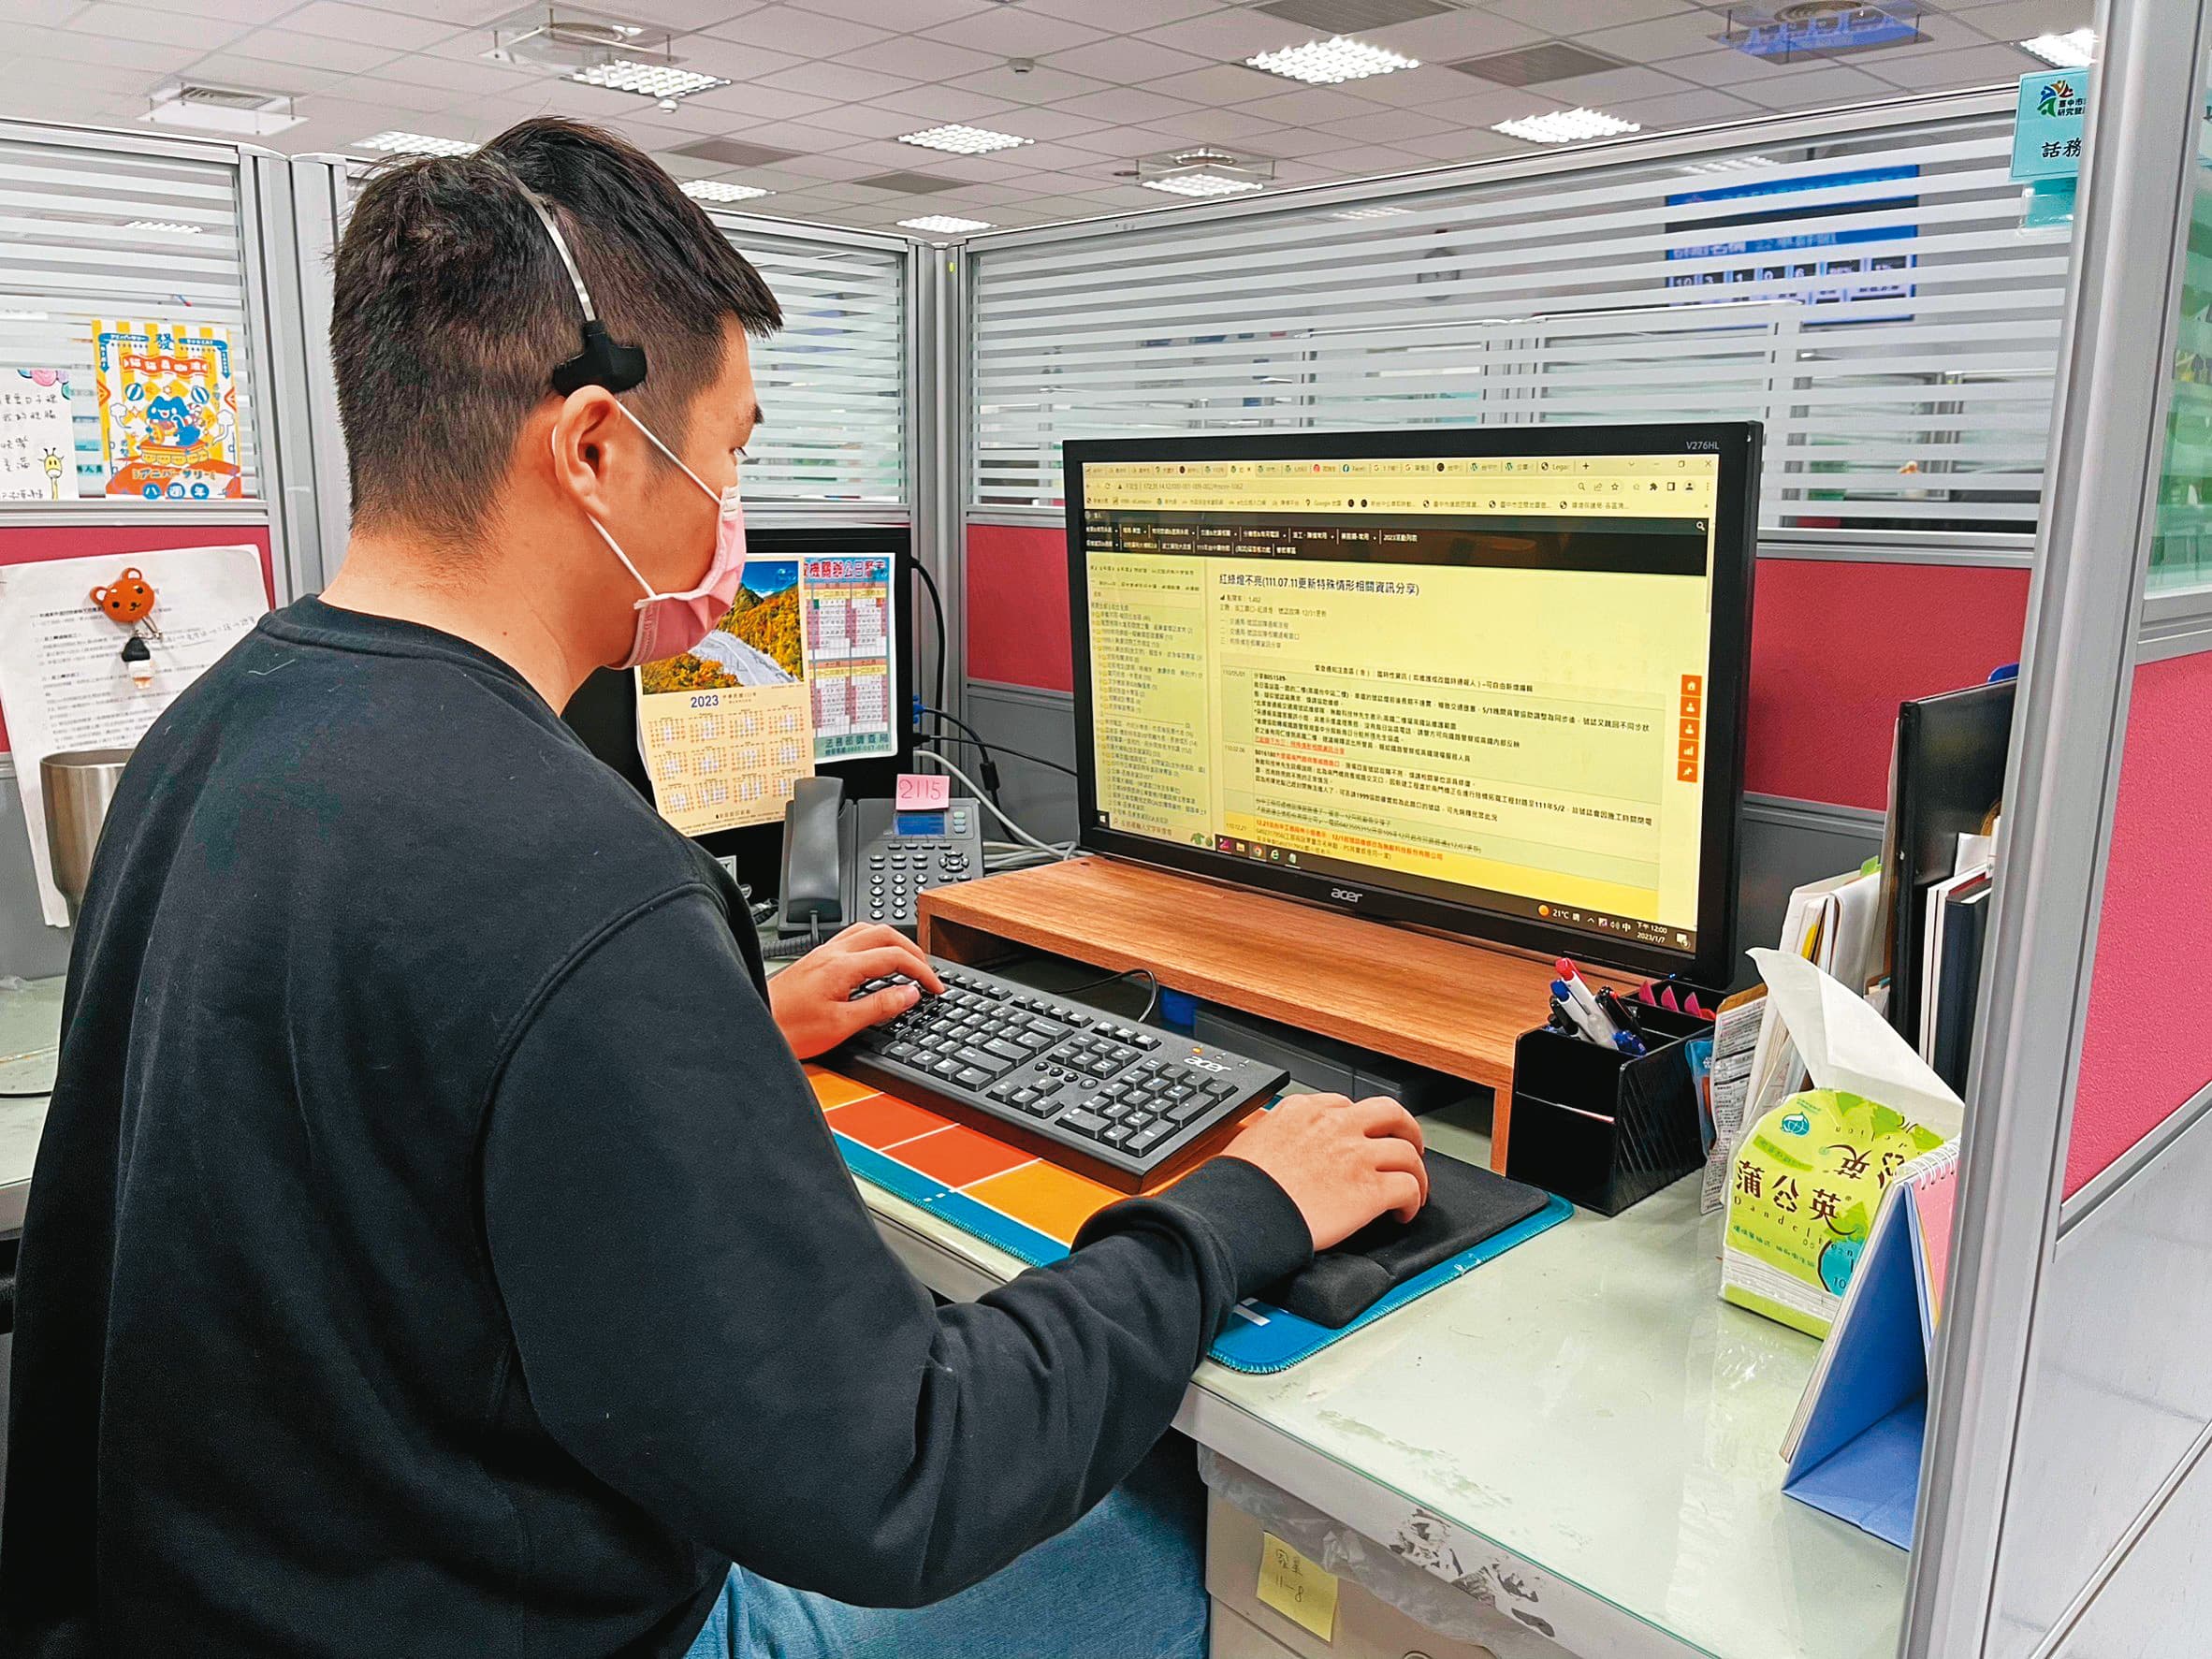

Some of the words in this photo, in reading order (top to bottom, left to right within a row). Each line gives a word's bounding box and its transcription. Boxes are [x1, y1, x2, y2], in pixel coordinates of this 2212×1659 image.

[2058, 108, 2087, 117] 研究發
[2042, 138, 2082, 158] 話務
[1685, 440, 1719, 450] V276HL
[691, 695, 720, 708] 2023
[899, 779, 941, 800] 2115
[1331, 887, 1363, 903] acer
[1552, 909, 1569, 920] 21°C
[1637, 931, 1666, 944] 2023/1/7
[1183, 1055, 1232, 1073] acer
[1736, 1160, 1857, 1235] 蒲公英
